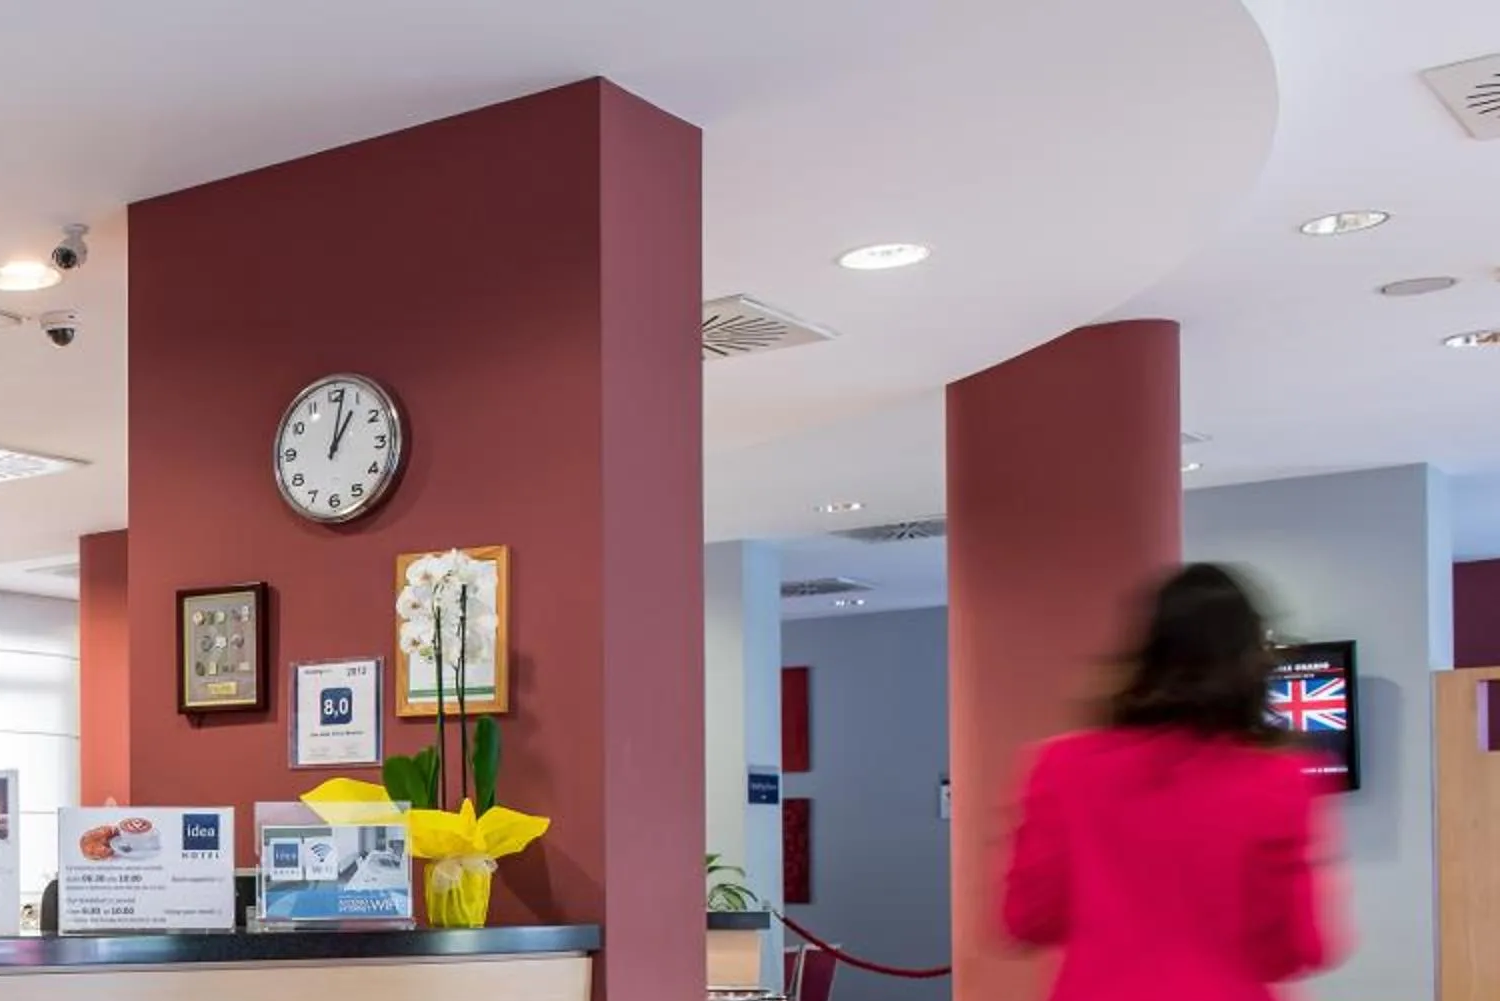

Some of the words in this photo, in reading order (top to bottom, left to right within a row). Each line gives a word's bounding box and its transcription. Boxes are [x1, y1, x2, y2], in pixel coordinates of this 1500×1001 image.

[355, 391, 360, 405] 1
[309, 401, 317, 415] 11
[367, 409, 379, 423] 2
[293, 421, 305, 435] 10
[374, 434, 386, 449] 3
[285, 448, 297, 462] 9
[368, 461, 379, 474] 4
[292, 473, 305, 487] 8
[308, 489, 318, 503] 7
[351, 483, 363, 497] 5
[328, 494, 341, 508] 6
[323, 697, 349, 720] 8,0
[186, 823, 216, 838] idea
[181, 852, 220, 860] HOTEL
